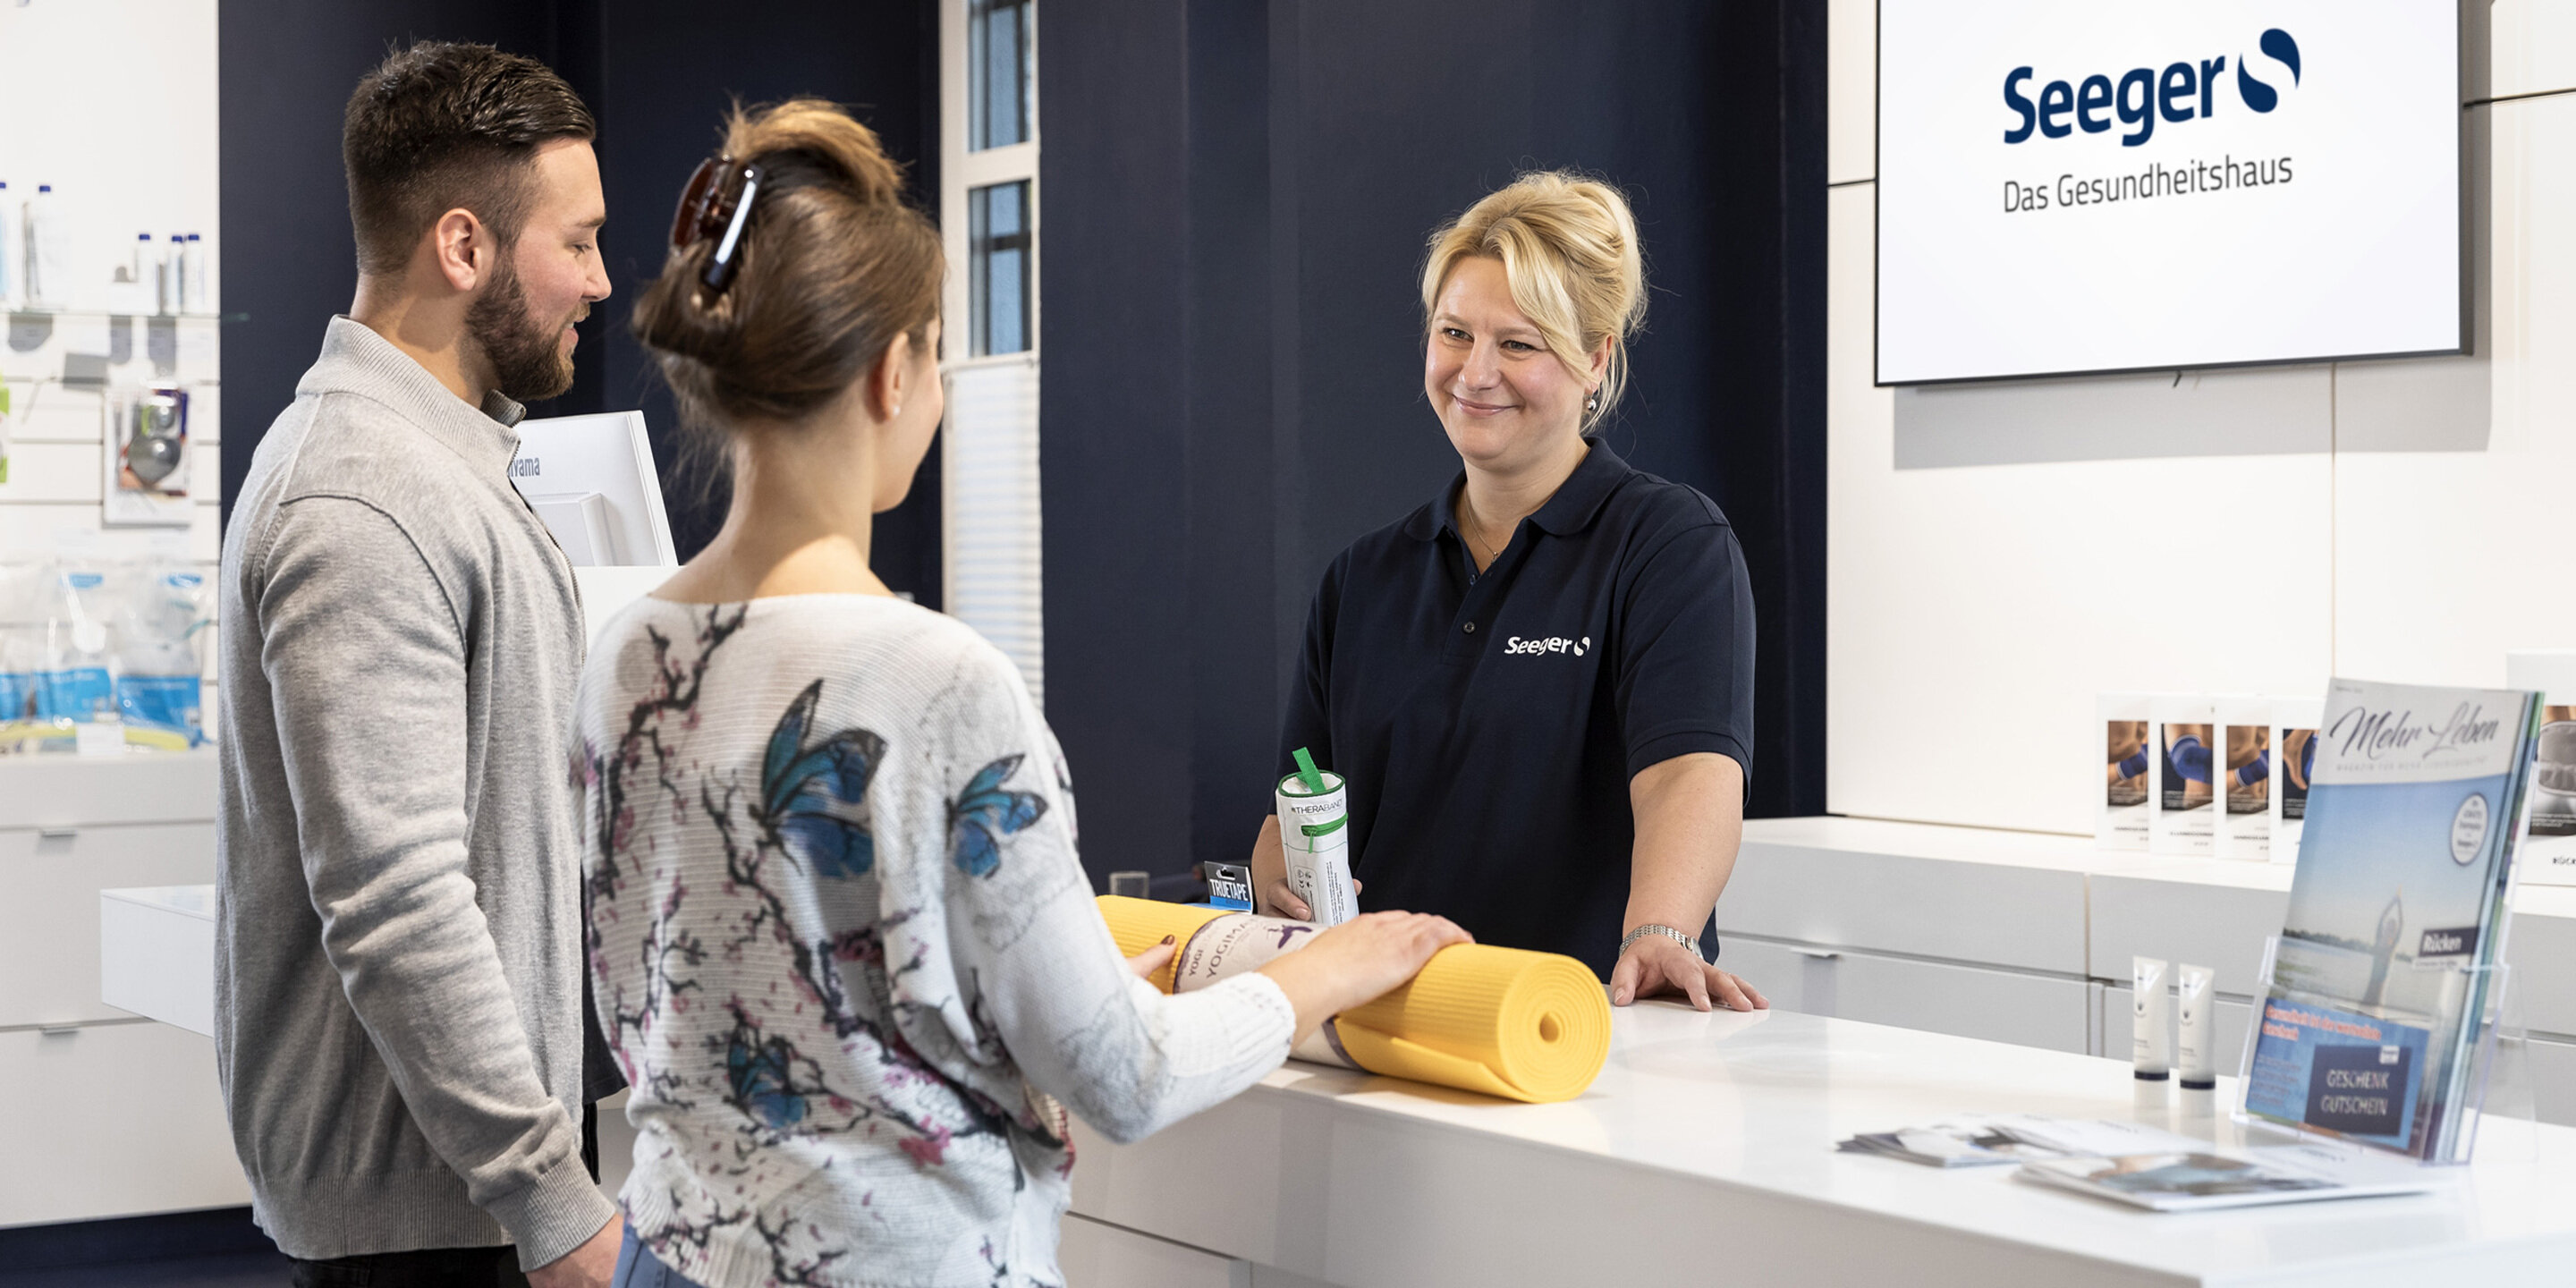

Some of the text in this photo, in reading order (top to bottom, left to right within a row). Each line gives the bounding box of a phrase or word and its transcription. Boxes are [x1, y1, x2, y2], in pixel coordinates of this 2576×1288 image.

[2004, 55, 2225, 147] Seeger
[2004, 154, 2293, 213] Das Gesundheitshaus
[508, 457, 540, 477] iyama
[1504, 636, 1572, 656] Seeger
[2329, 700, 2499, 760] Mehr Leben
[1209, 878, 1249, 902] TRUETAPE
[2422, 932, 2462, 953] Rücken
[1189, 949, 1204, 977] YOGI
[2326, 1069, 2391, 1090] GESCHENK
[2320, 1094, 2389, 1116] GUTSCHEIN
